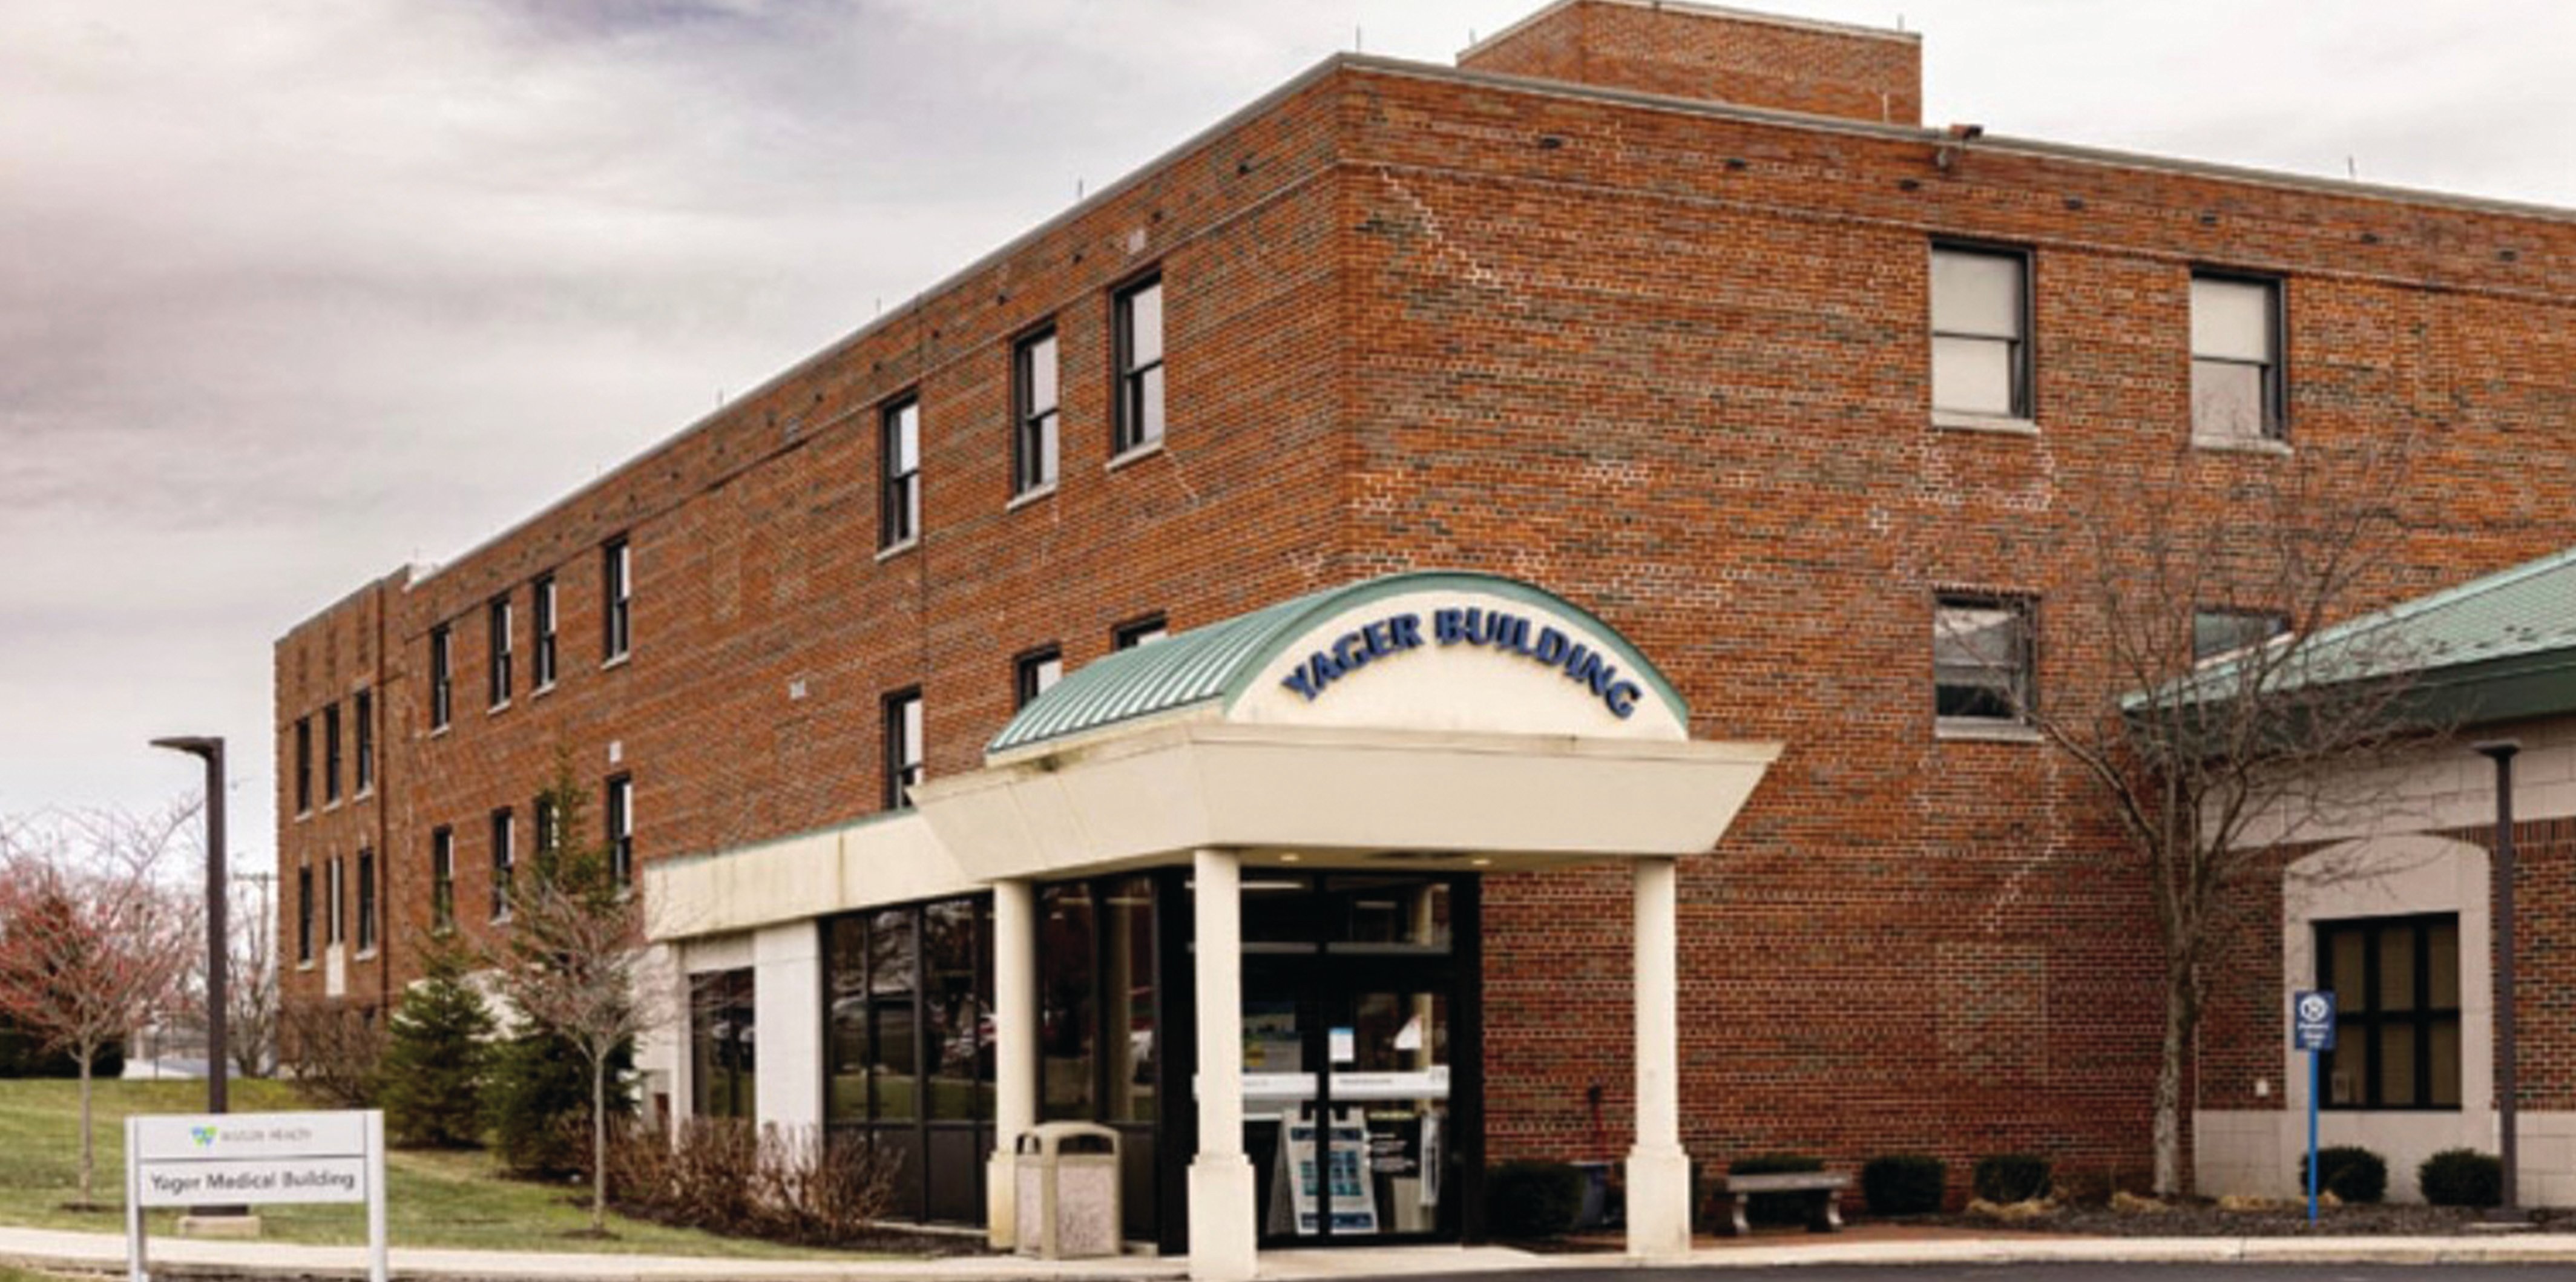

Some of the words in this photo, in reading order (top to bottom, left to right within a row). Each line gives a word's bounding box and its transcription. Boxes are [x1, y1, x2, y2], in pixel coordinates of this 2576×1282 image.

[1281, 613, 1424, 702] YAGER
[1434, 607, 1642, 720] BUILDING
[152, 1174, 200, 1195] Yager
[206, 1172, 275, 1189] Medical
[283, 1171, 354, 1191] Building
